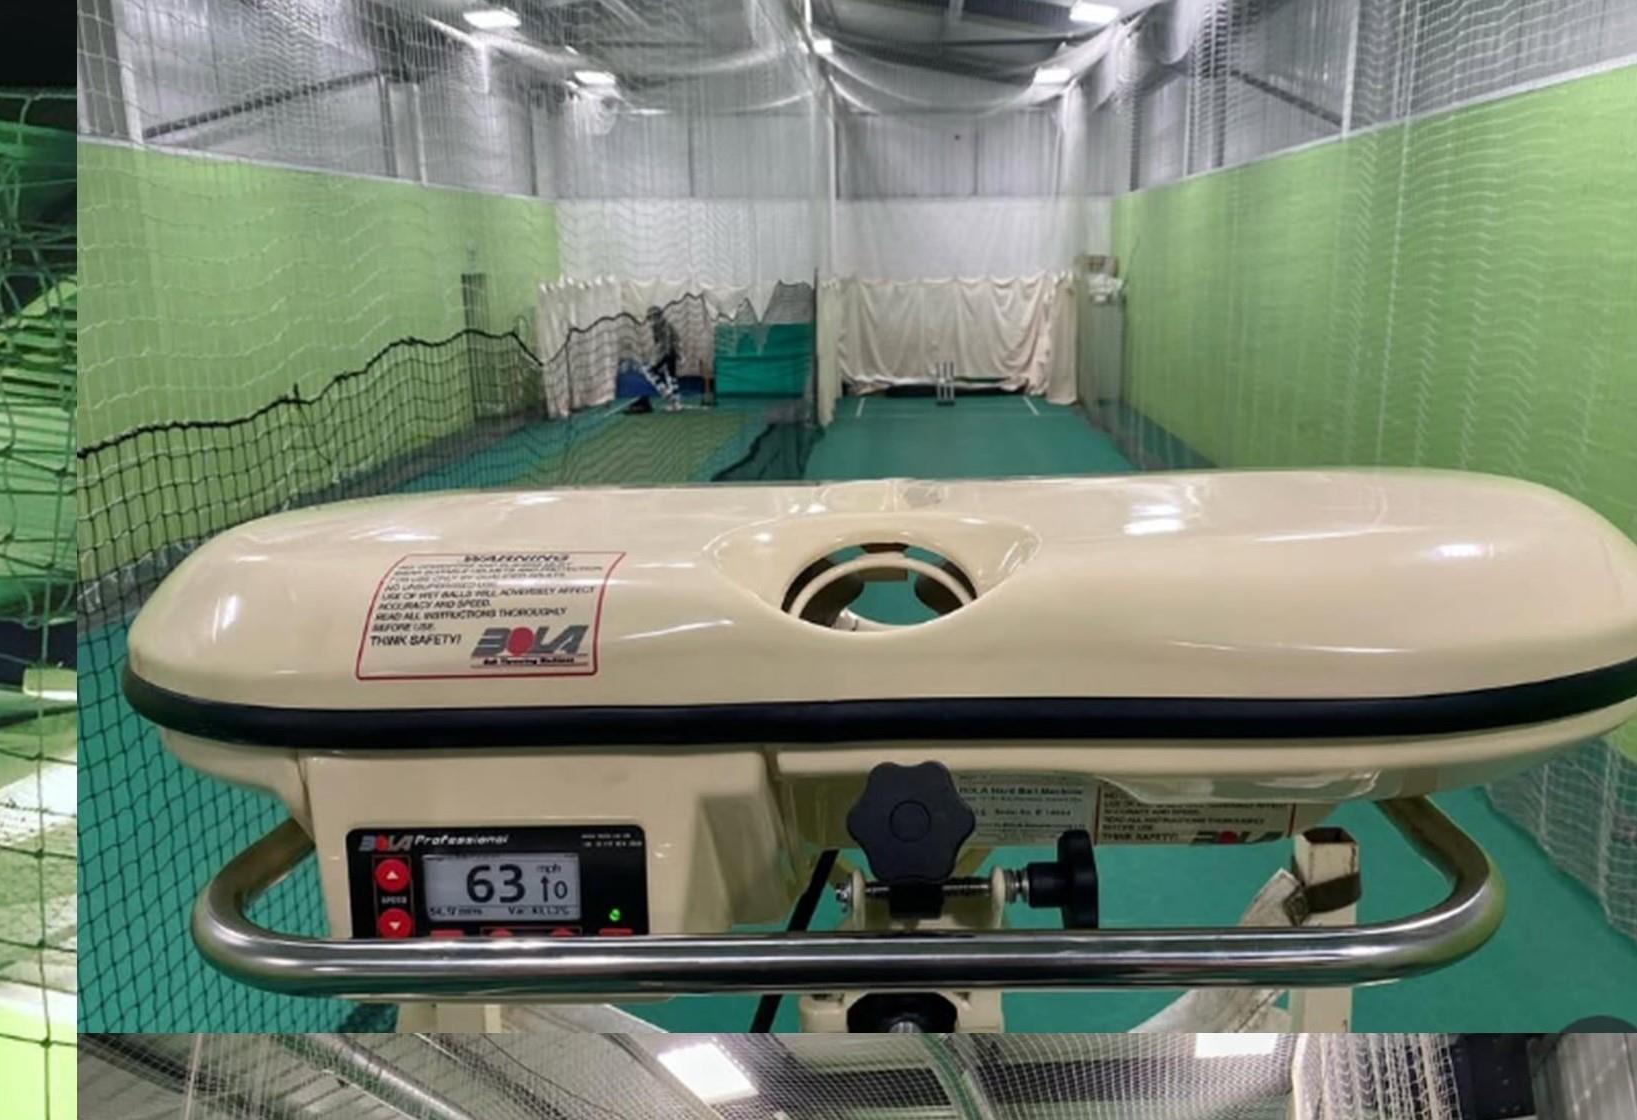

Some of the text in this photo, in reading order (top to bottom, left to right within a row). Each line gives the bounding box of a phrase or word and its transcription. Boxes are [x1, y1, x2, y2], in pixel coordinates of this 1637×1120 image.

[382, 591, 401, 600] USE
[403, 591, 417, 599] OF
[418, 590, 440, 599] WET
[440, 589, 473, 599] BALLS
[498, 587, 556, 596] ADVERSELY
[557, 585, 595, 595] AFFECT
[378, 601, 432, 610] ACCURACY
[433, 600, 456, 609] AND
[376, 607, 567, 621] READ ALL INSTRUCTIONS THOROUGHLY
[372, 622, 412, 632] BEFORE
[370, 632, 463, 647] THINK SAFETY!
[471, 625, 589, 657] BOLA
[358, 834, 510, 852] BOLA Professional
[536, 862, 562, 874] mph
[466, 863, 526, 904] 63
[554, 880, 569, 899] 0
